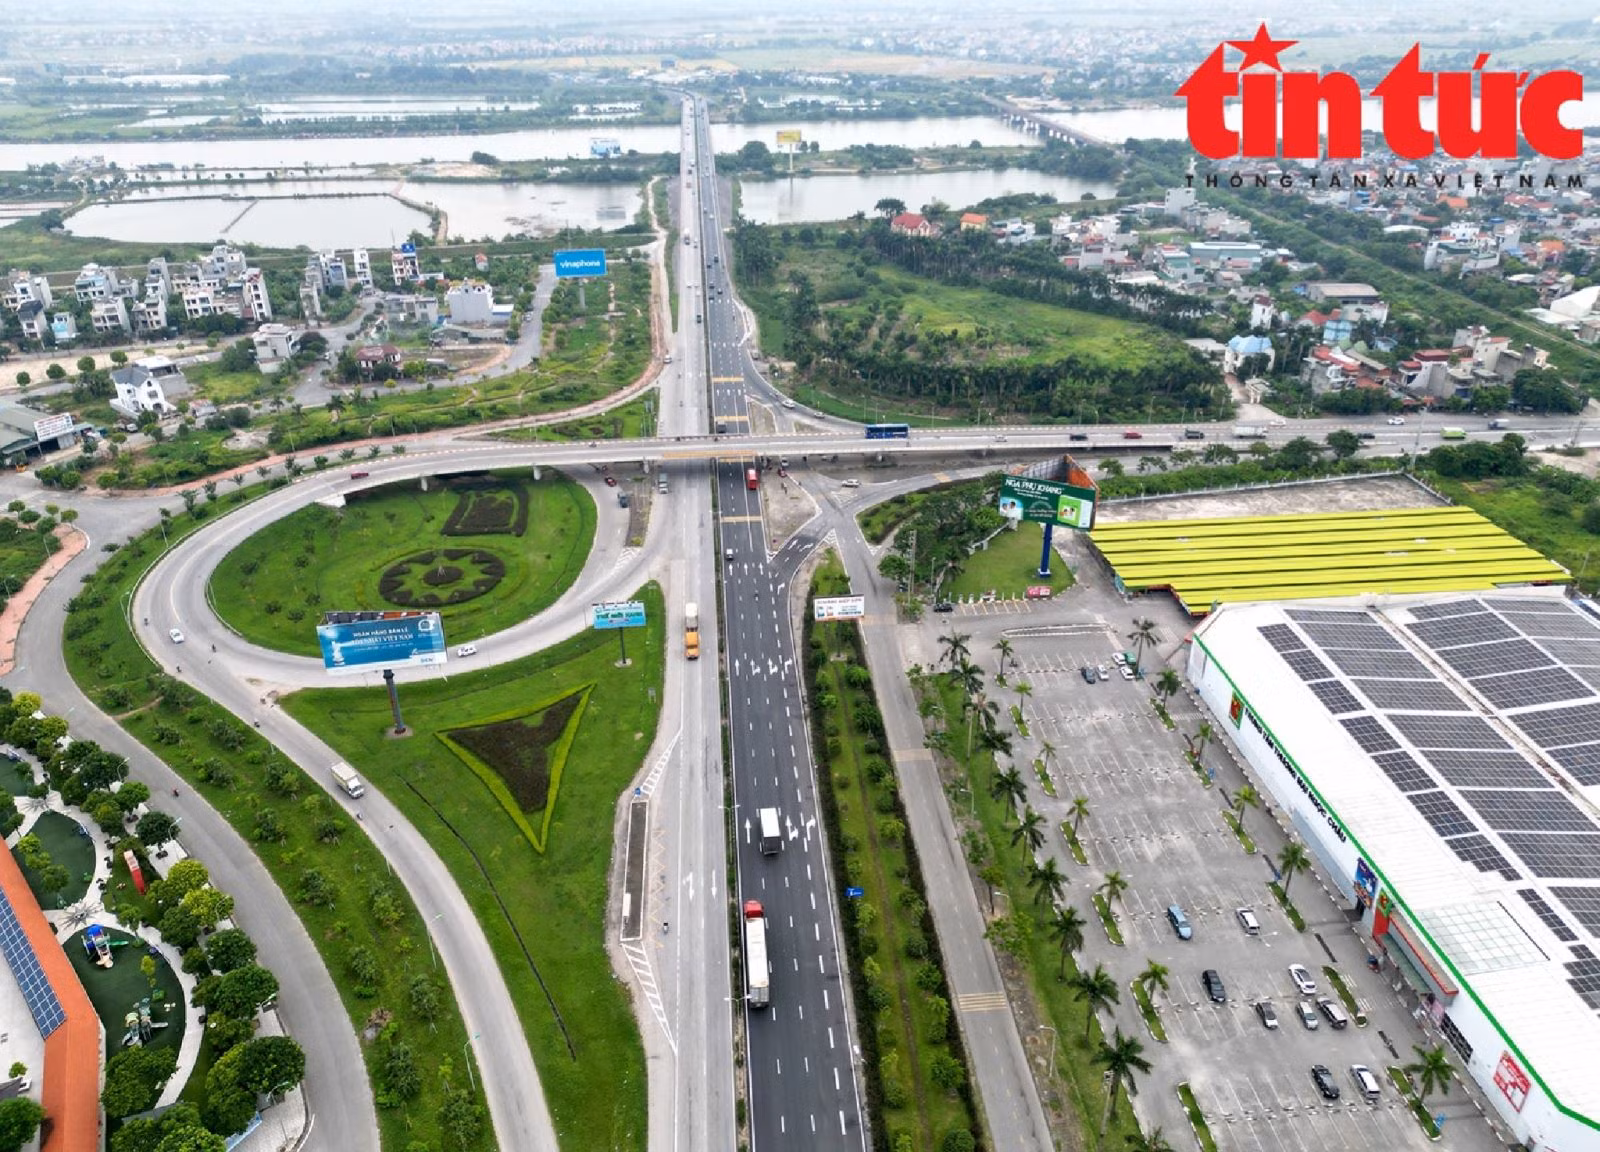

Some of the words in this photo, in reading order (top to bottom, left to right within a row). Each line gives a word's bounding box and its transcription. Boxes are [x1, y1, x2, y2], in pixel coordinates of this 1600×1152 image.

[560, 259, 601, 269] vinaphone
[1004, 479, 1020, 488] NGA
[1327, 816, 1347, 843] CHÂU
